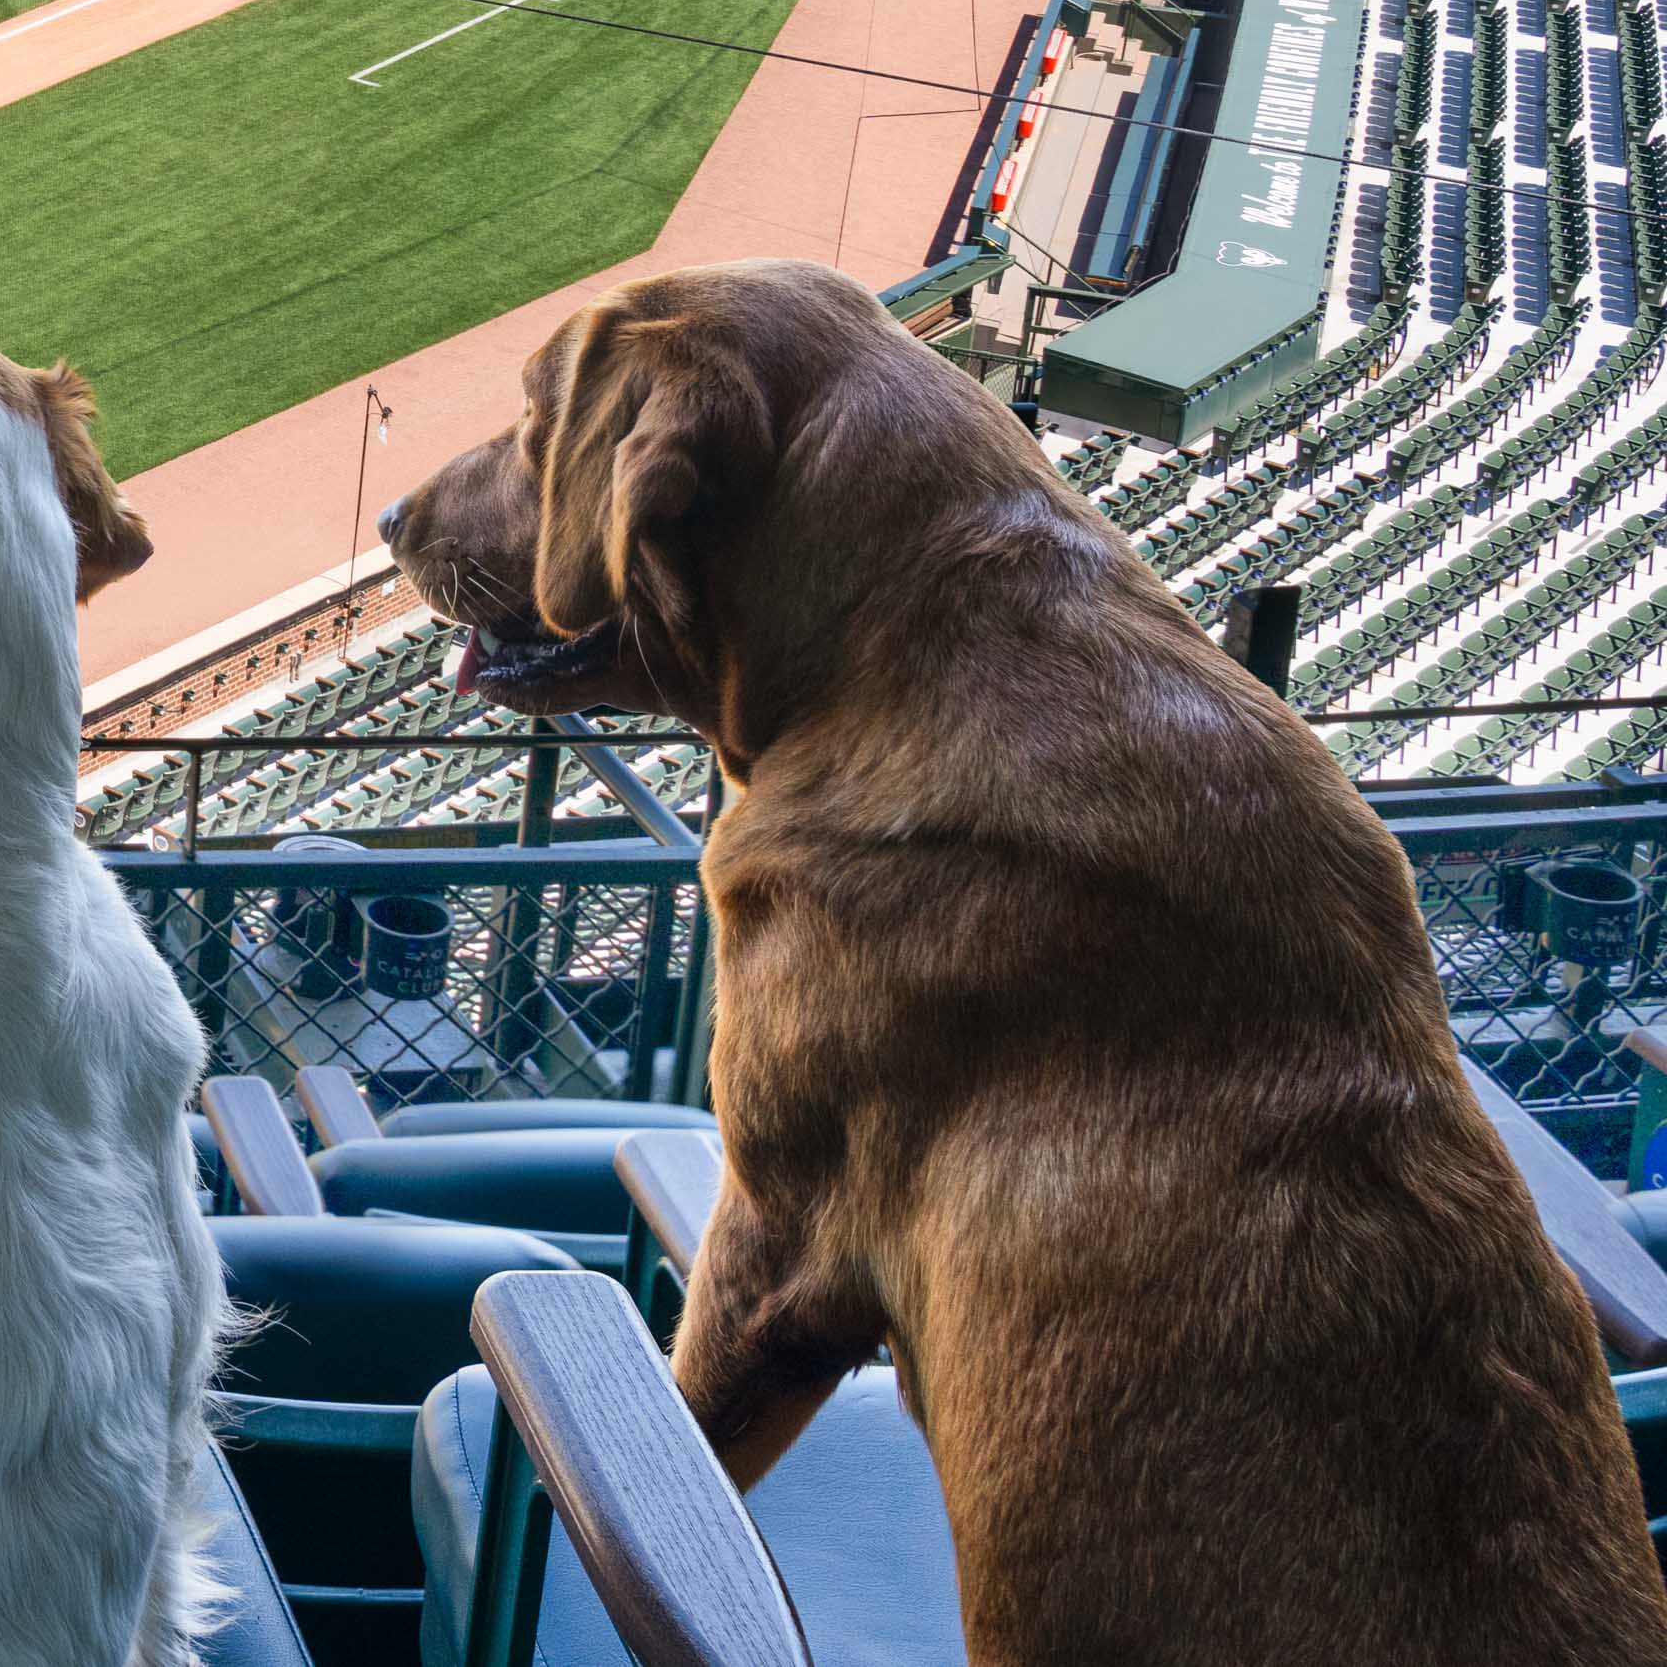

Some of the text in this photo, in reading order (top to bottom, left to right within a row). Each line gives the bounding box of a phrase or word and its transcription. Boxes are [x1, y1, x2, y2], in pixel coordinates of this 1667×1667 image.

[1264, 23, 1327, 79] CONFINES
[1253, 75, 1317, 135] FRIENDLY
[1240, 176, 1300, 229] Welcome
